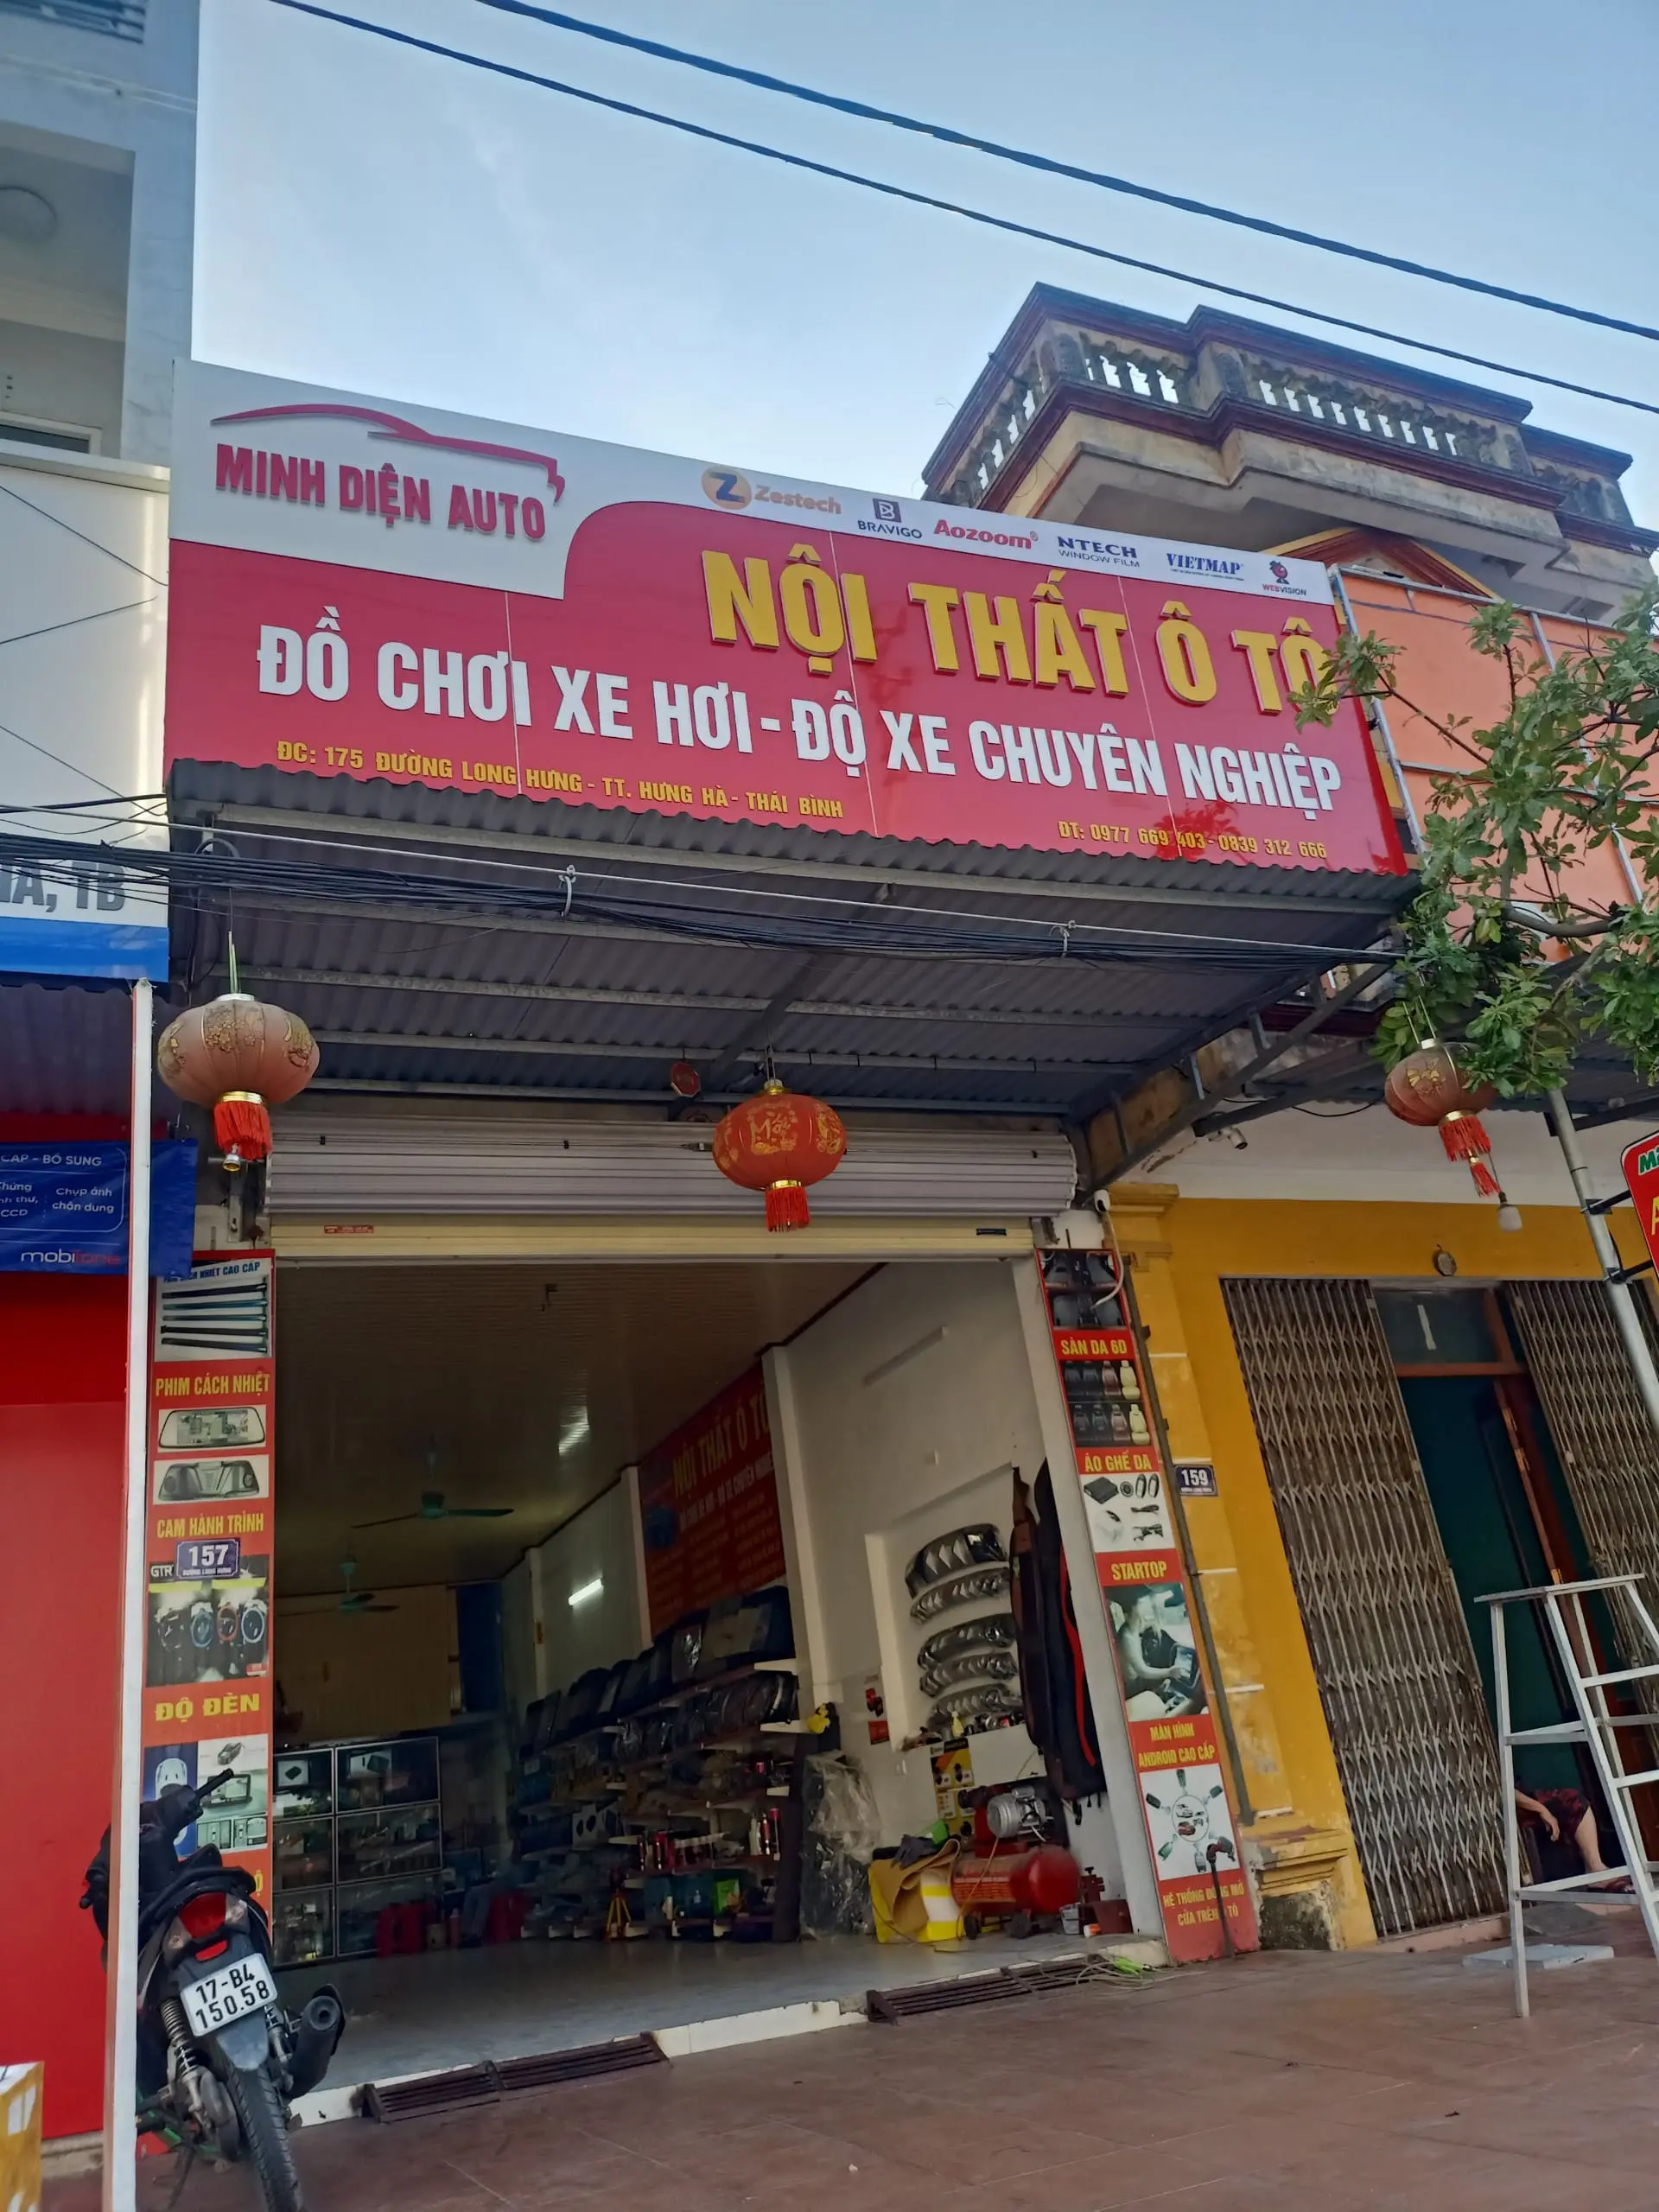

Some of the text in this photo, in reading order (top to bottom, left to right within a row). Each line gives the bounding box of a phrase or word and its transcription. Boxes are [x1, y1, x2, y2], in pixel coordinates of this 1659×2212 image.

[216, 443, 547, 541] MINH DIỆN AUTO
[754, 485, 842, 515] Zestech
[858, 520, 923, 540] BRAVIGO
[1058, 536, 1138, 559] NTECH
[1058, 550, 1141, 568] WINDOW FILM
[1166, 553, 1241, 575] VIETMAP
[1262, 584, 1306, 595] WEBVISION
[702, 543, 1338, 717] NỘI THẤT Ô TÔ
[256, 606, 350, 702] ĐỒ
[377, 641, 532, 727] CHƠI
[550, 664, 633, 741] XE
[652, 677, 753, 754] HƠI
[791, 690, 867, 779] ĐỘ
[879, 710, 957, 776] XE
[968, 720, 1166, 798] CHUYÊN
[1174, 743, 1342, 821] NGHIỆP
[277, 740, 317, 764] ĐC:
[325, 747, 364, 769] 175
[375, 748, 453, 779] ĐƯỜNG
[461, 760, 518, 786] LONG
[526, 768, 583, 792] HƯNG
[602, 777, 632, 798] TT.
[639, 780, 694, 804] HƯNG
[702, 785, 729, 808] HÀ
[746, 790, 789, 813] THÁI
[798, 793, 843, 818] BÌNH
[1090, 824, 1130, 843] 0977
[1138, 827, 1168, 846] 669
[1218, 834, 1259, 854] 0839
[1264, 838, 1293, 856] 312
[1298, 841, 1327, 859] 666
[66, 1155, 102, 1166] SUNG
[55, 1187, 87, 1197] Chụp
[84, 1203, 114, 1214] dung
[222, 1264, 239, 1276] CAO
[1061, 1337, 1128, 1356] SÀN DA 6D
[156, 1370, 270, 1396] PHIM CÁCH NHIỆT
[1084, 1449, 1152, 1472] ÁO GHẾ DA
[1181, 1469, 1209, 1487] 159
[156, 1510, 264, 1539] CAM HÀNH TRÌNH
[188, 1543, 229, 1567] 157
[1111, 1560, 1167, 1581] STARTOP
[155, 1692, 260, 1723] ĐỘ ĐÈN
[1149, 1723, 1173, 1741] MÀN
[1138, 1749, 1178, 1768] ANDROID
[1178, 1746, 1197, 1763] CAO
[196, 1963, 255, 2005] 17-B4
[195, 1980, 270, 2029] 150.58
